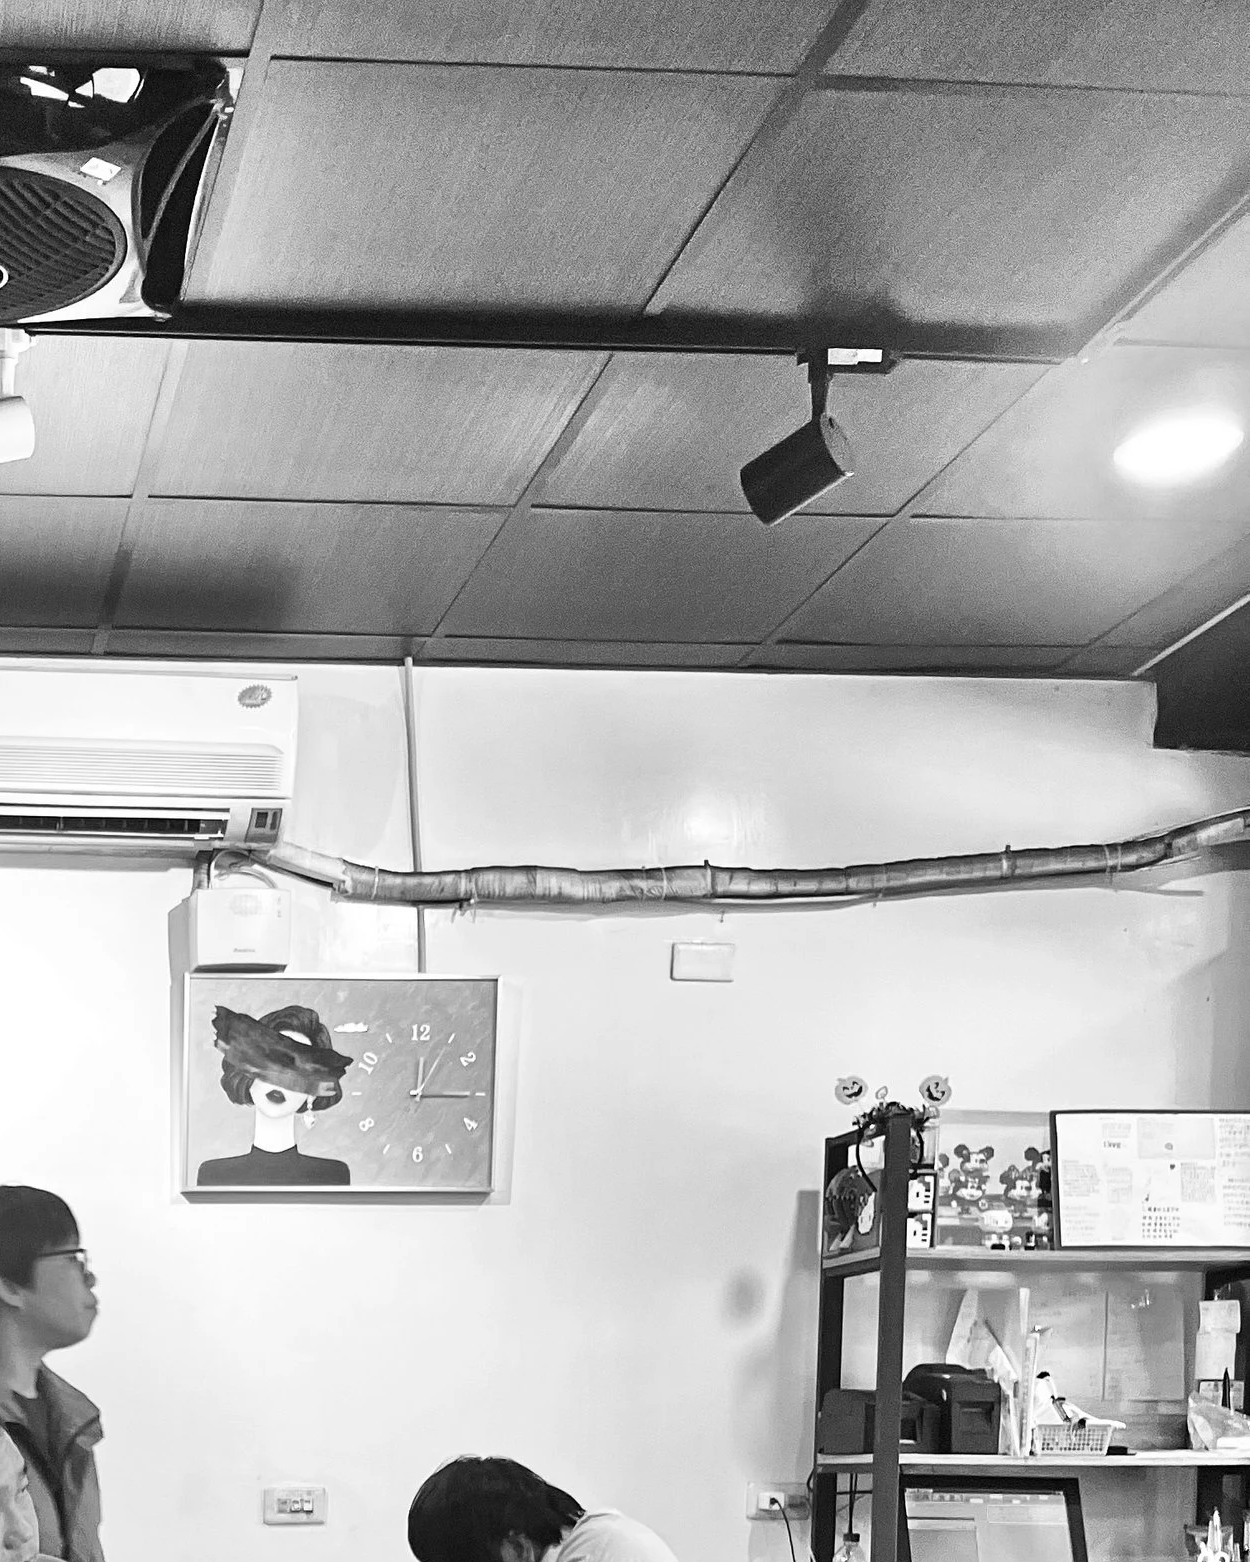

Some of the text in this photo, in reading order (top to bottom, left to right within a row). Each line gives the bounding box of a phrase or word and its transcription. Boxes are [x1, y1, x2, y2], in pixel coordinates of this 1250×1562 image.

[411, 1024, 431, 1041] 12
[358, 1052, 378, 1075] 10
[460, 1052, 476, 1067] 2
[359, 1117, 375, 1132] 8
[463, 1117, 478, 1132] 4
[412, 1146, 423, 1163] 6
